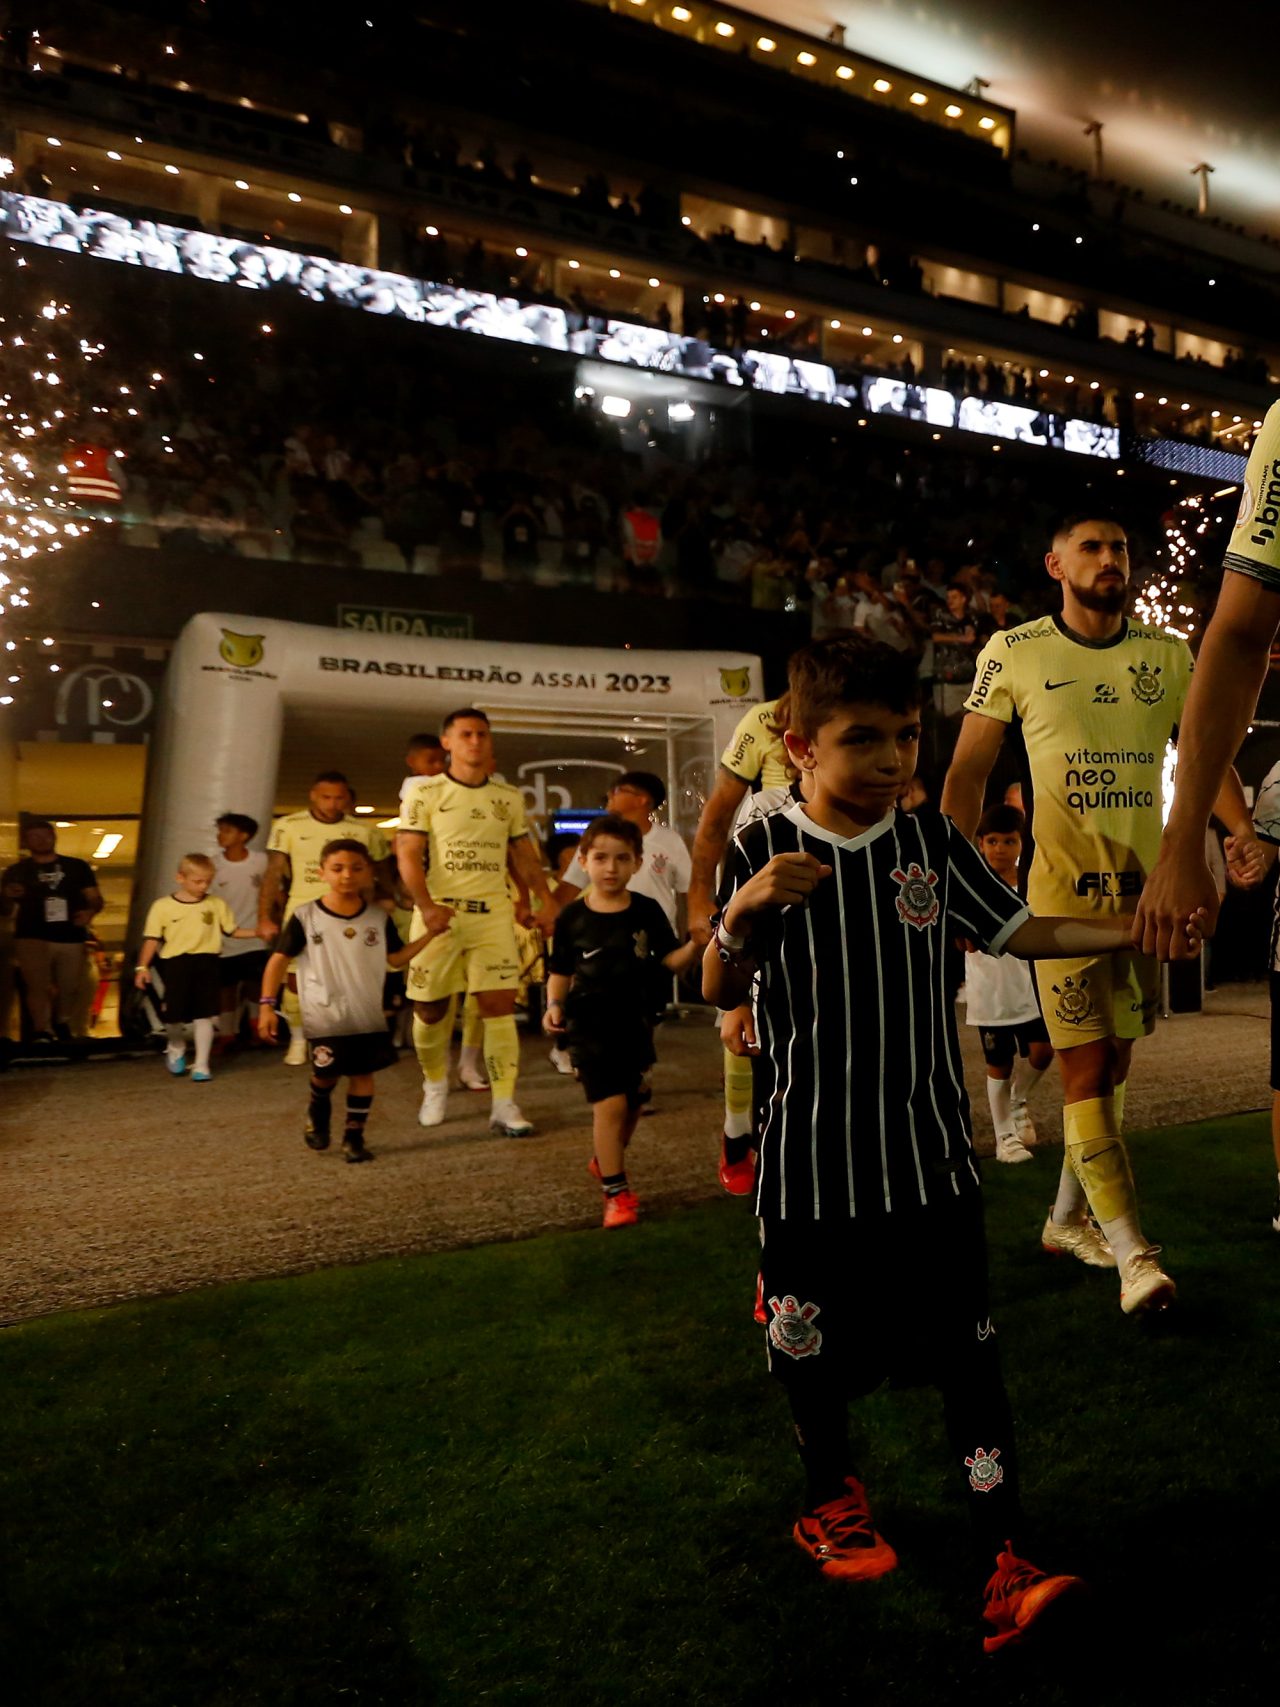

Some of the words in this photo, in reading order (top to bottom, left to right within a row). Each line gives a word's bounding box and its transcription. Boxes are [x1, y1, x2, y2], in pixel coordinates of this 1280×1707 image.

[1004, 625, 1058, 648] pixbet
[320, 656, 522, 685] BRASILEIRÃO
[605, 673, 671, 694] 2023
[979, 659, 1003, 700] bmg
[1064, 749, 1155, 764] vitaminas
[1066, 769, 1116, 787] neo
[1067, 786, 1153, 815] química
[446, 850, 477, 859] neo
